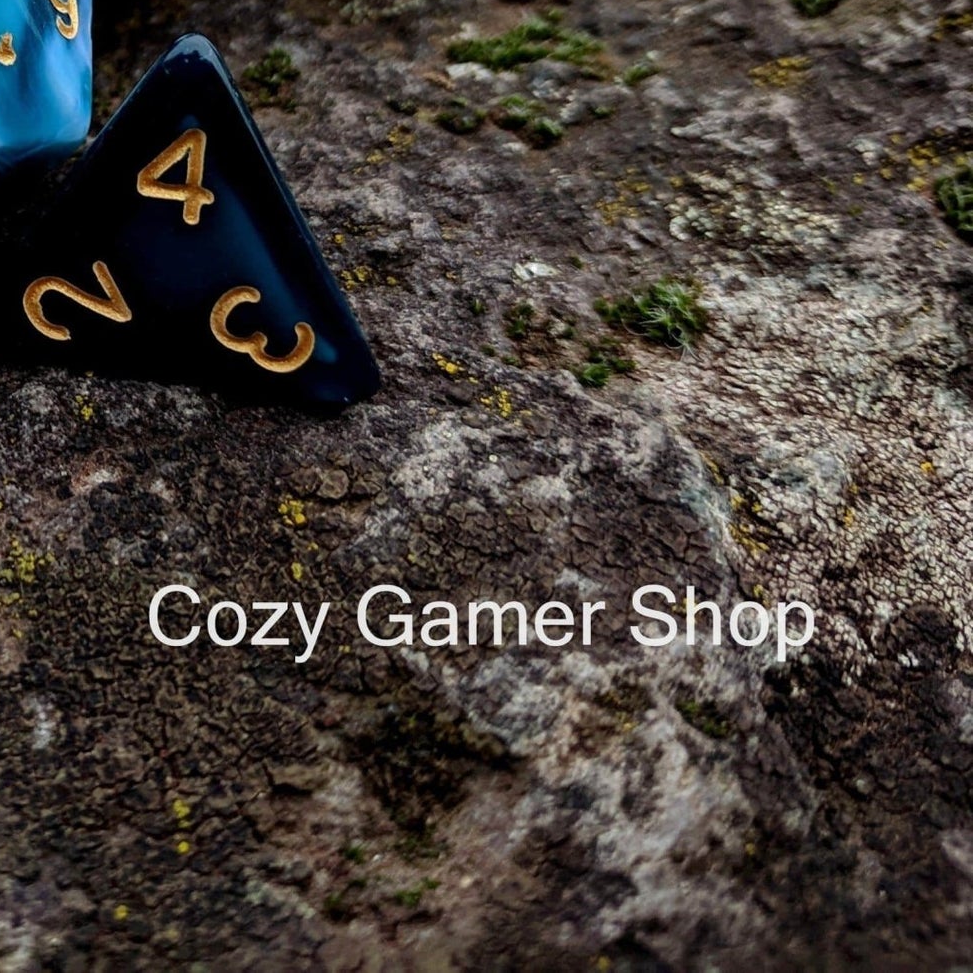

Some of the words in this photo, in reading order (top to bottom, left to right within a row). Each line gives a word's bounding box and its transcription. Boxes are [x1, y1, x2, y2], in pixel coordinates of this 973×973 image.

[137, 128, 215, 226] 4
[23, 260, 133, 341] 2
[210, 285, 316, 374] 3
